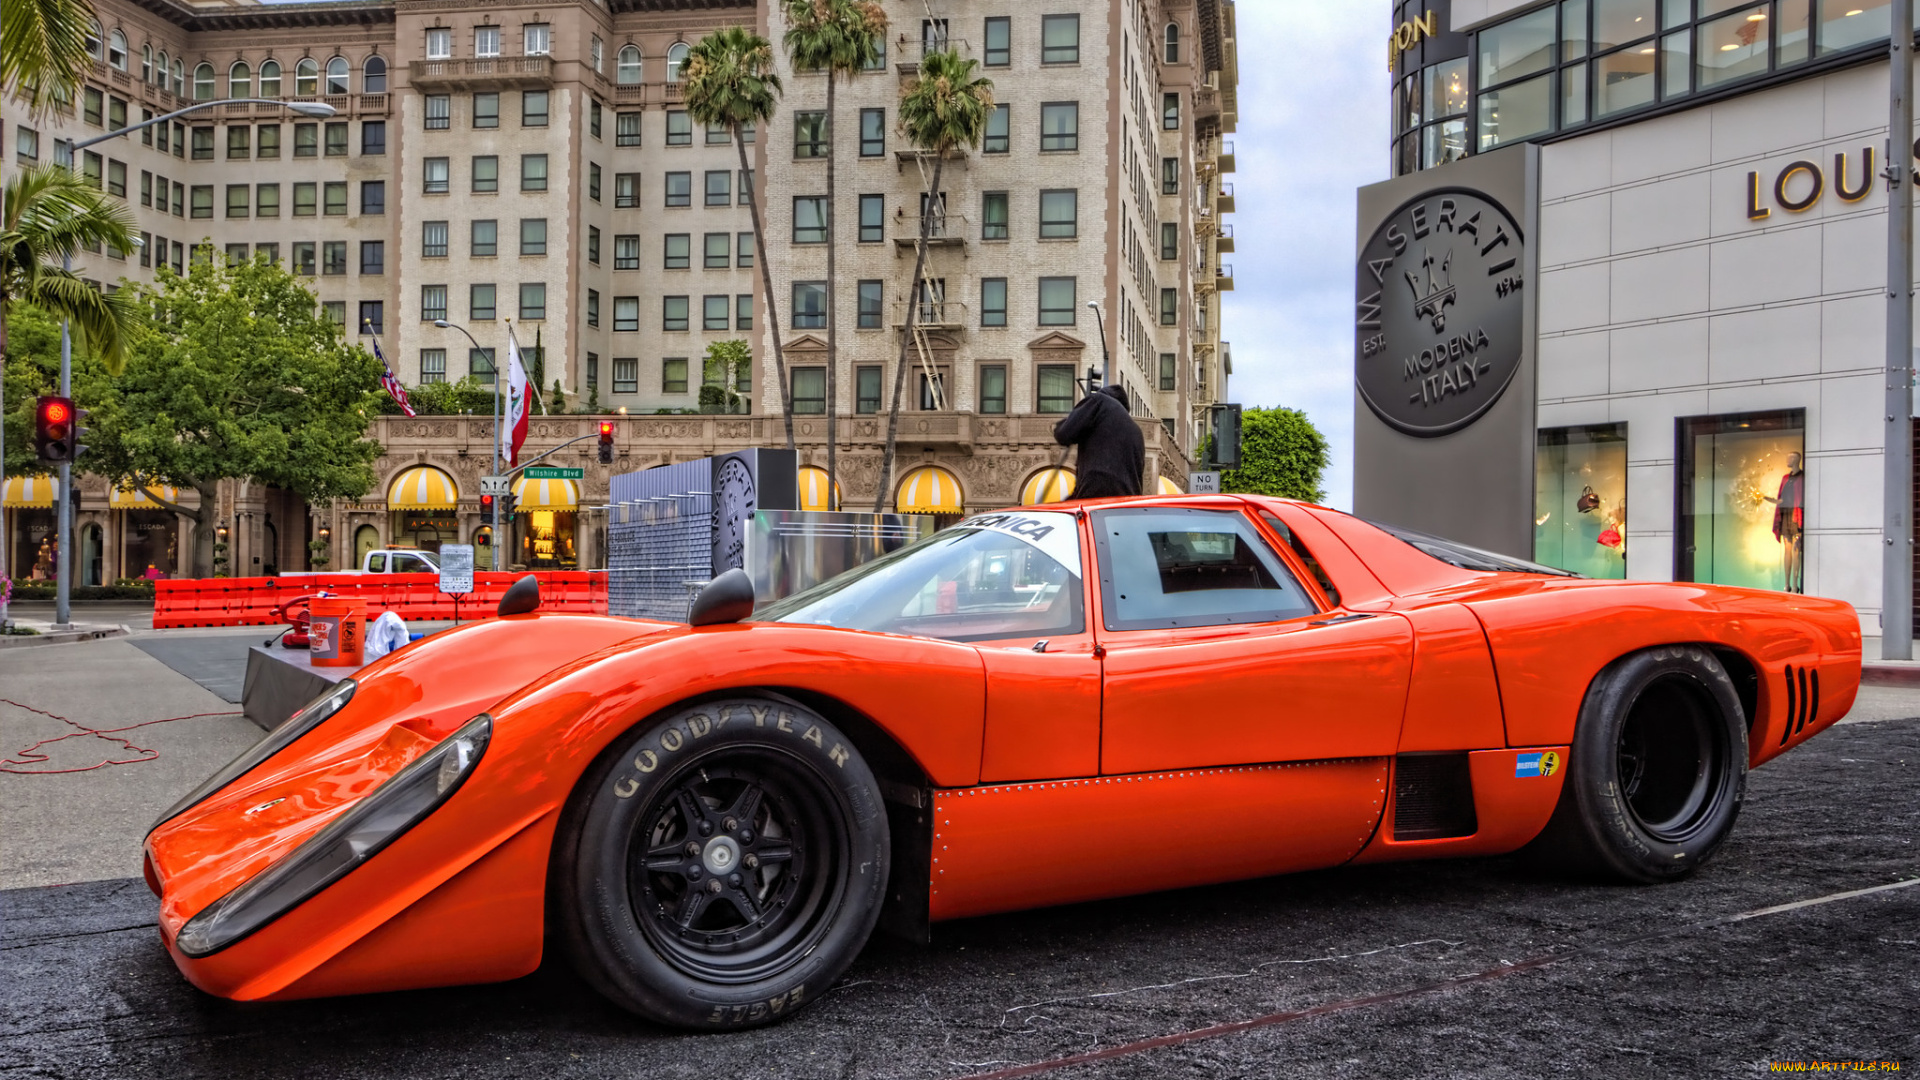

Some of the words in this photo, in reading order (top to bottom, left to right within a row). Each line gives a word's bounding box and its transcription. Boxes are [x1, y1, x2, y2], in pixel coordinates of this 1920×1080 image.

[1356, 198, 1516, 331] MASERATI
[1403, 325, 1490, 382] MODENA
[1197, 475, 1212, 483] NO
[1195, 484, 1213, 492] TURN
[138, 523, 166, 531] ESCADA
